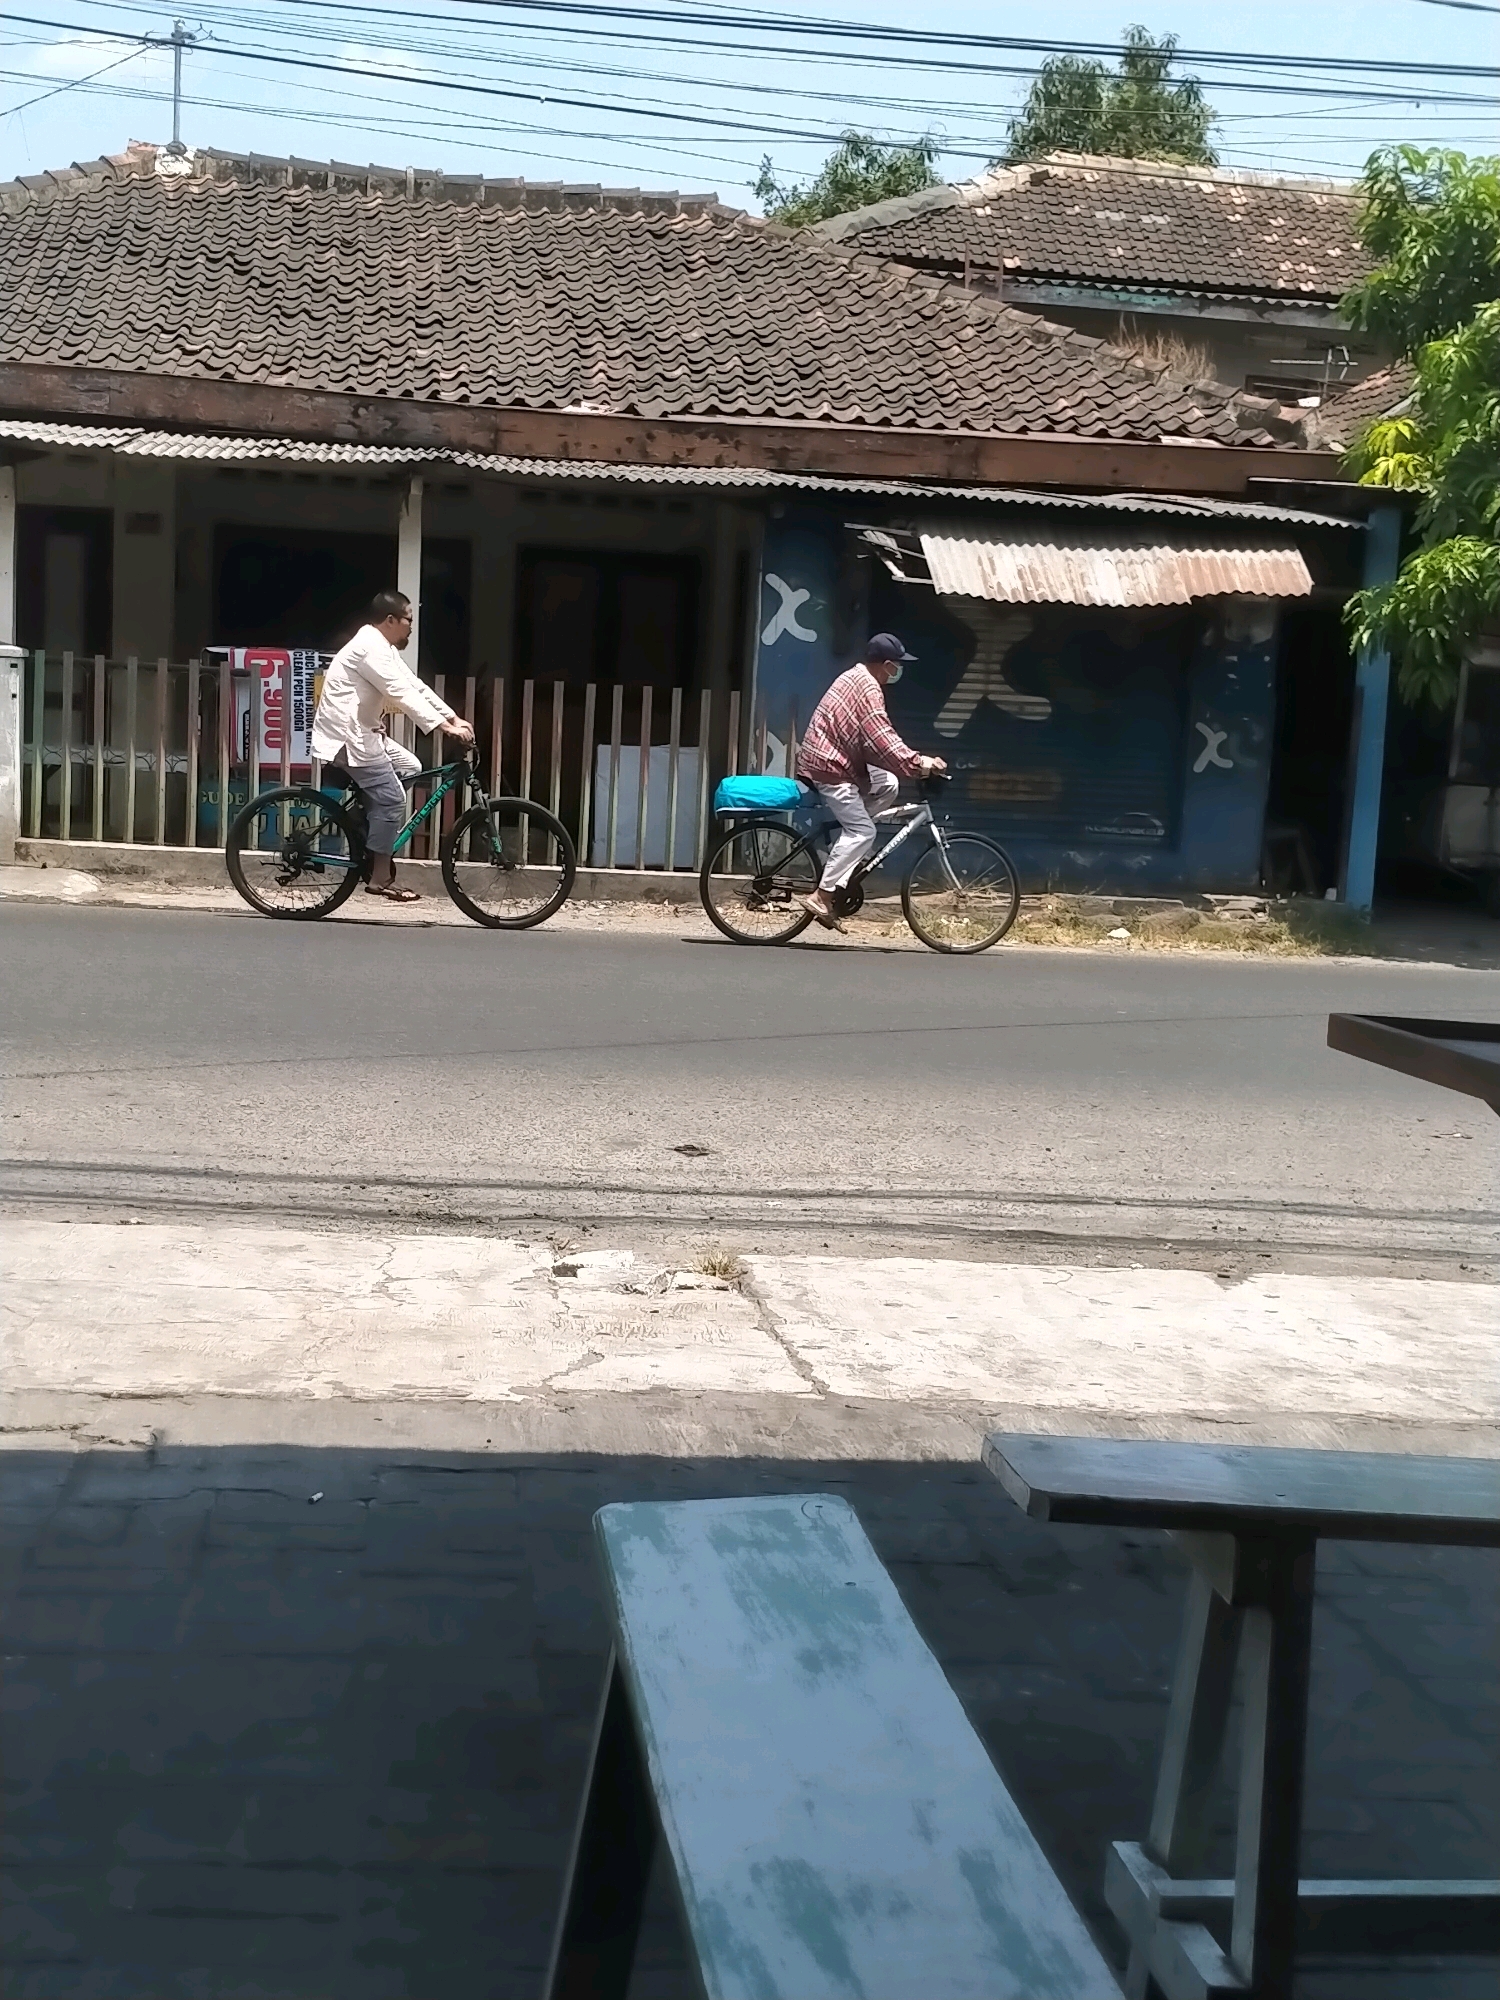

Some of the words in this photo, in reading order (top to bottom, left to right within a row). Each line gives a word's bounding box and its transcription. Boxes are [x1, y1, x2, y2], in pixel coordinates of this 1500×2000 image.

[293, 651, 304, 677] CLEAN
[293, 679, 304, 696] PCH
[293, 698, 305, 732] 1500GR
[408, 778, 457, 834] POLYGON
